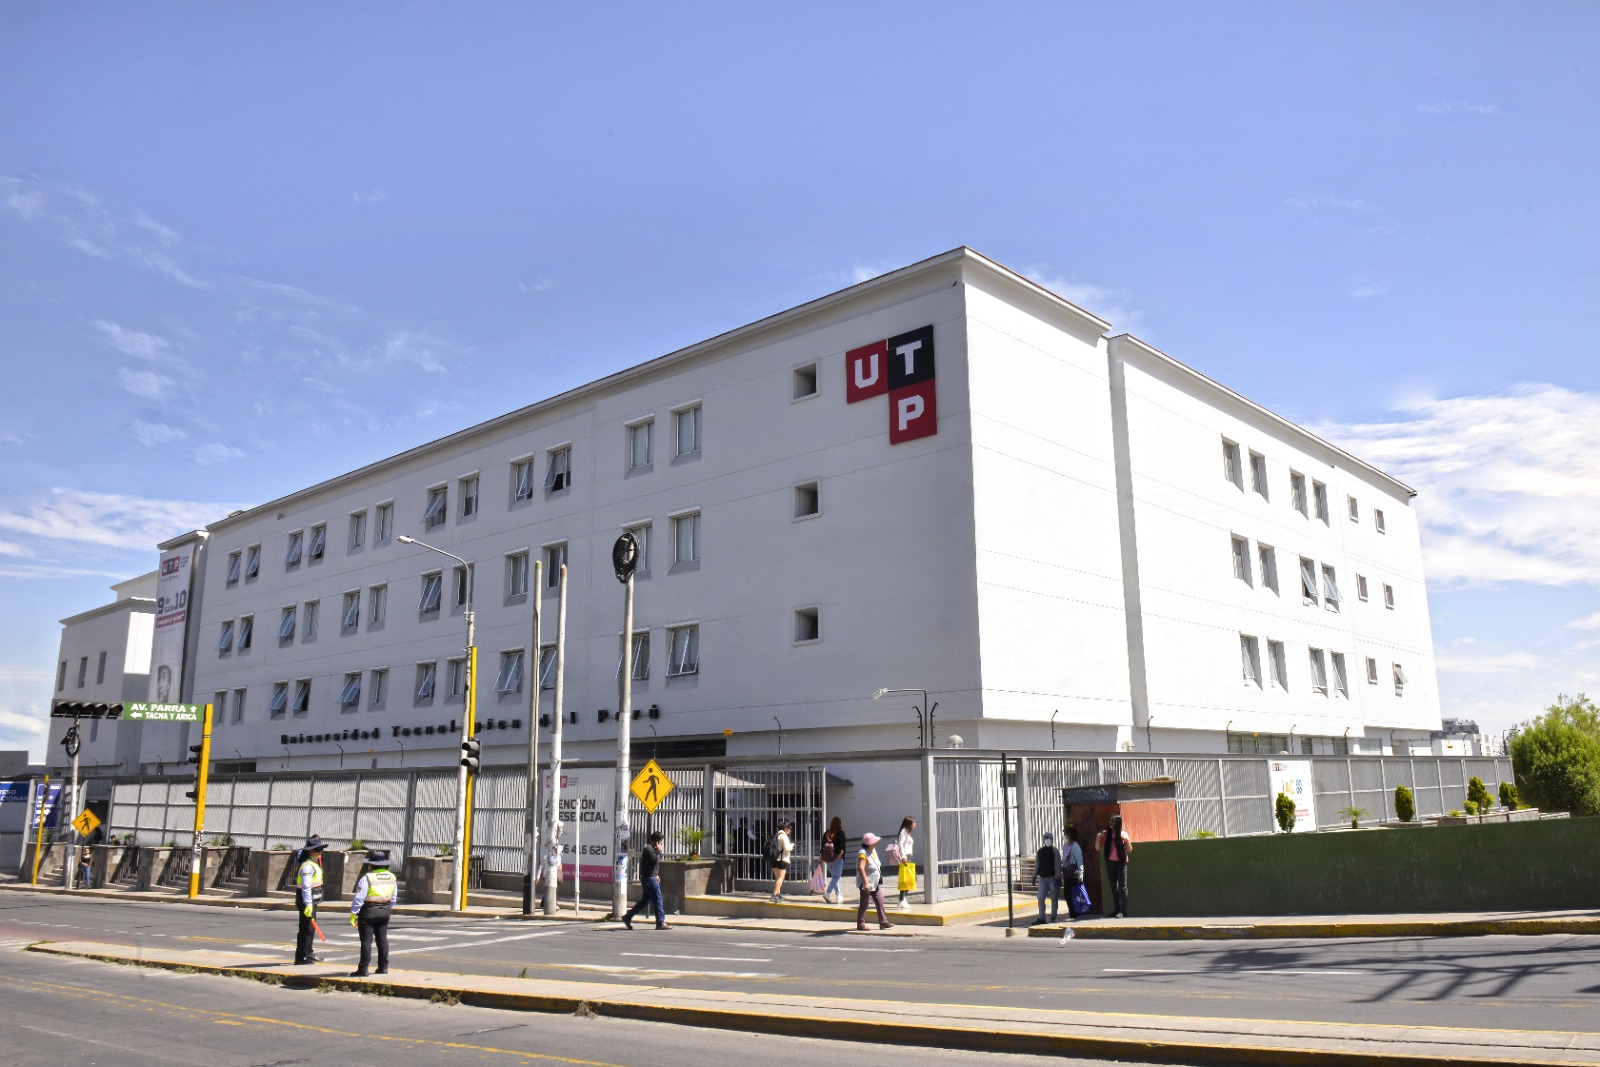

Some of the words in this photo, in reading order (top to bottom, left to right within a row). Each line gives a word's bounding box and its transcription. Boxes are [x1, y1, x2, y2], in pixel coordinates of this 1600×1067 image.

[163, 558, 179, 573] UTP
[157, 596, 165, 614] 9
[173, 590, 187, 611] 10
[130, 703, 148, 711] AV.
[150, 703, 186, 712] PARRA
[145, 711, 168, 719] TACNA
[169, 712, 176, 720] Y
[391, 718, 521, 737] Tecnolgica
[539, 711, 576, 727] dl
[545, 795, 596, 810] ENCÓN
[545, 810, 609, 823] ESENCIAL
[589, 845, 607, 855] 620
